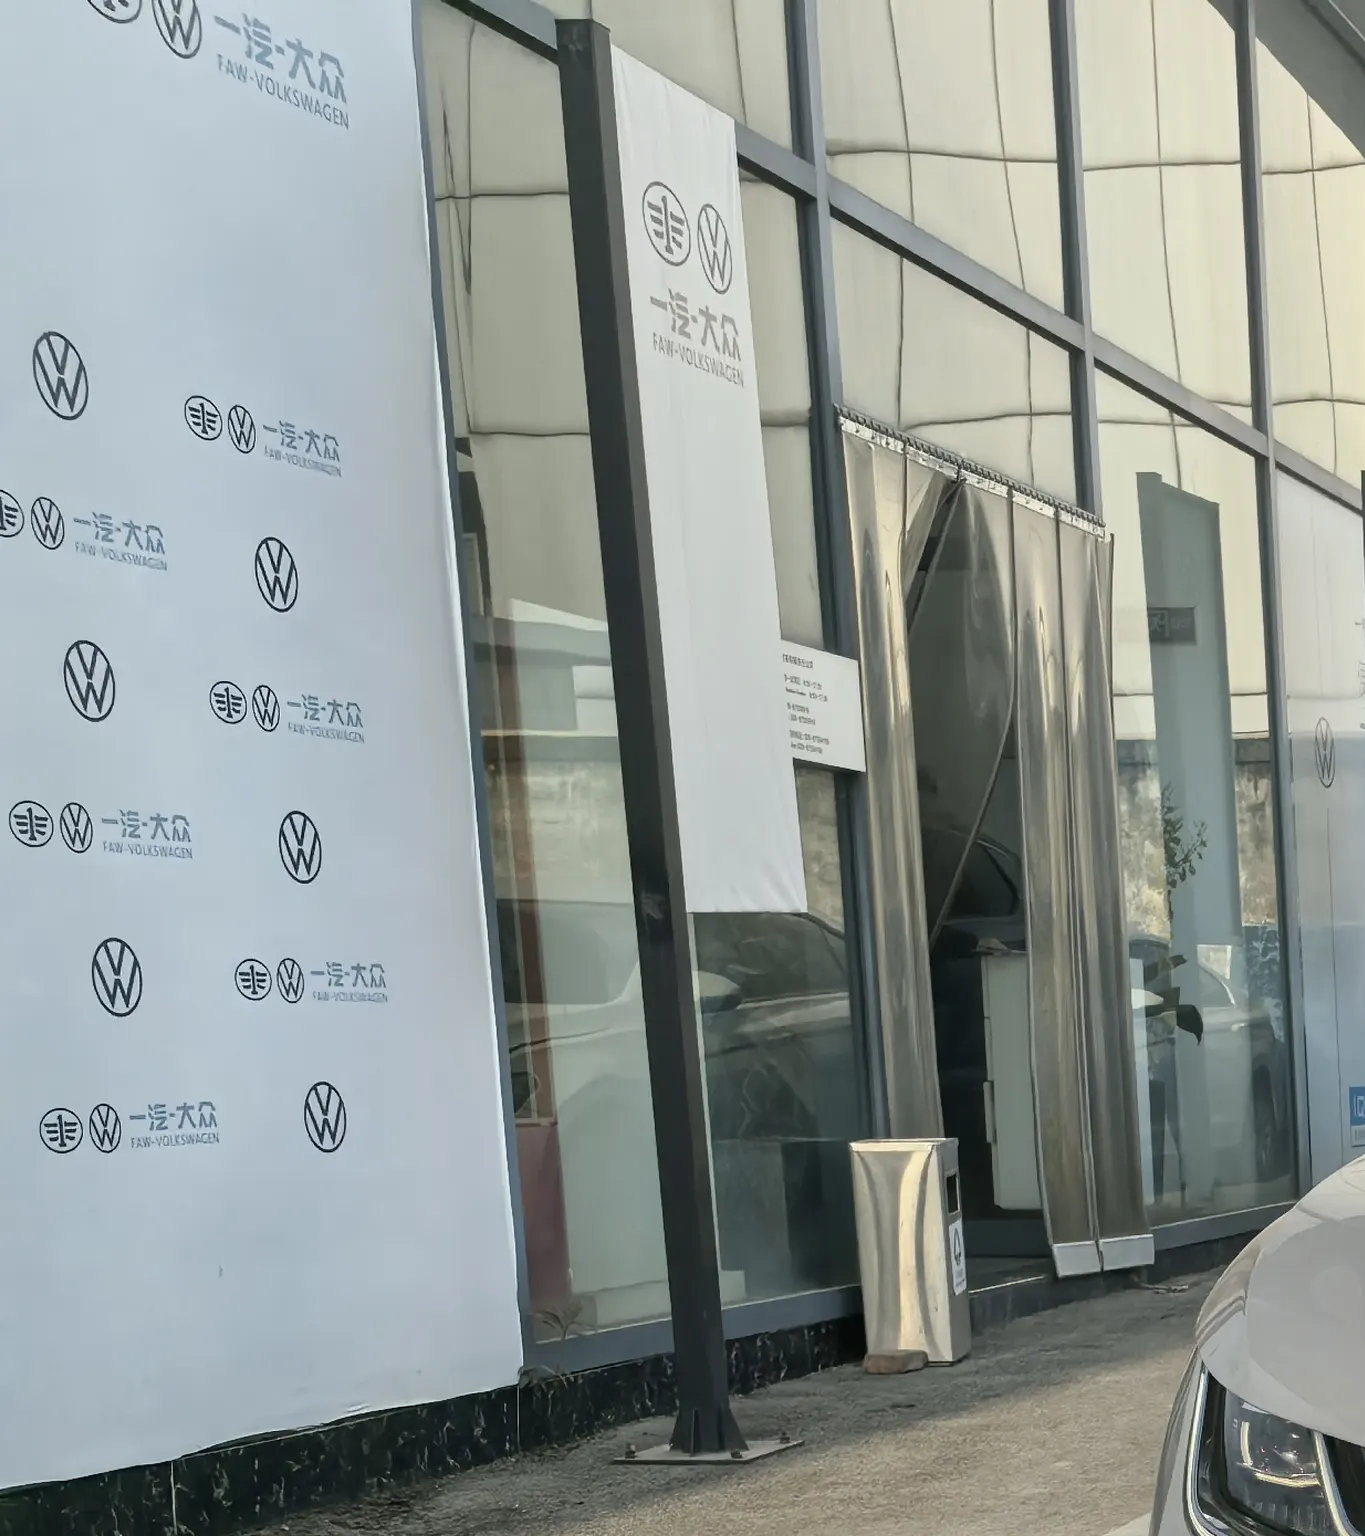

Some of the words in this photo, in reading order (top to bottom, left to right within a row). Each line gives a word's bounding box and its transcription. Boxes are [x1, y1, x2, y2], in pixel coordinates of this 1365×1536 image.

[217, 54, 349, 130] FAW-VOLKSWAGEN
[653, 332, 744, 388] FAW-VOLKSWAGEN
[103, 841, 193, 860] FAW-VOLKSWAGEN
[131, 1132, 219, 1149] FAW-VOLKSWAGEN
